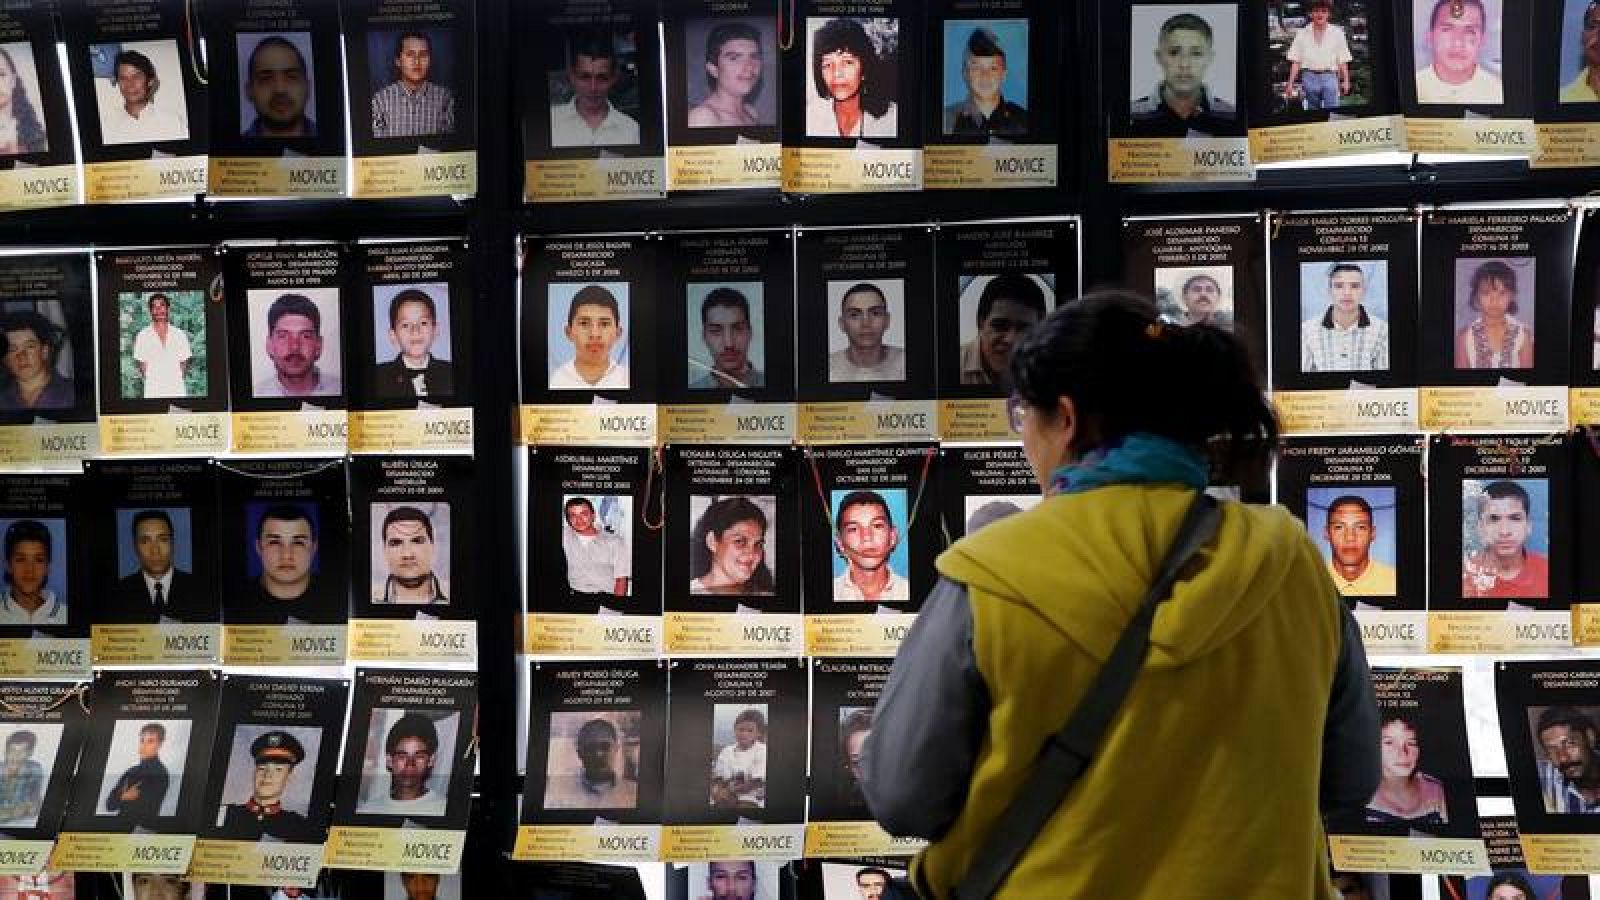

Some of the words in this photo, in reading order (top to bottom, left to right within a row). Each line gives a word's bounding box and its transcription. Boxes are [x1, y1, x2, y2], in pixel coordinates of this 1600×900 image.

[1339, 129, 1393, 145] MOVICE
[1475, 131, 1526, 145] MOVICE
[996, 158, 1045, 174] MOVICE
[1194, 151, 1245, 167] MOVICE
[159, 168, 205, 185] MOVICE
[290, 170, 337, 184] MOVICE
[424, 164, 468, 180] MOVICE
[608, 170, 655, 185] MOVICE
[863, 163, 912, 179] MOVICE
[24, 178, 69, 195] MOVICE
[1530, 214, 1568, 223] PALACIO
[1315, 226, 1373, 234] DESAPARECIDO
[1320, 235, 1358, 243] COMUNA
[1357, 402, 1409, 417] MOVICE
[1505, 401, 1559, 416] MOVICE
[424, 421, 471, 435] MOVICE
[600, 417, 647, 432] MOVICE
[737, 417, 785, 432] MOVICE
[877, 414, 927, 430] MOVICE
[176, 425, 219, 439] MOVICE
[42, 436, 87, 451] MOVICE
[679, 450, 717, 459] ROSALBA
[718, 449, 746, 459] ÚSUGA
[748, 450, 783, 458] HIGUITA
[853, 447, 895, 457] MARTÍNEZ
[1338, 447, 1387, 455] JARAMILLO
[597, 454, 638, 464] MARTÍNEZ
[845, 458, 897, 466] DESAPARECIDO
[1324, 455, 1379, 464] DESAPARECIDO
[1327, 465, 1363, 473] COMUNA
[561, 481, 594, 489] OCTUBRE
[835, 475, 869, 483] OCTUBRE
[604, 628, 652, 642] MOVICE
[743, 626, 792, 641] MOVICE
[1362, 624, 1415, 639] MOVICE
[1516, 624, 1568, 639] MOVICE
[165, 636, 209, 652] MOVICE
[291, 638, 337, 652] MOVICE
[420, 633, 467, 649] MOVICE
[37, 650, 83, 665] MOVICE
[718, 663, 759, 671] ALEXANDER
[821, 664, 858, 673] CLAUDIA
[160, 678, 199, 687] DURANGO
[366, 675, 402, 686] HERNÁN
[403, 676, 430, 686] DARÍO
[431, 677, 475, 687] PULGARÍN
[717, 680, 752, 689] COMUNA
[1543, 680, 1599, 689] DESAPARECIDO
[391, 687, 447, 696] DESAPARECIDO
[704, 689, 737, 697] AGOSTO
[598, 837, 649, 850] MOVICE
[742, 835, 793, 850] MOVICE
[133, 847, 182, 861] MOVICE
[402, 843, 451, 859] MOVICE
[1421, 849, 1476, 864] MOVICE
[262, 856, 311, 871] MOVICE
